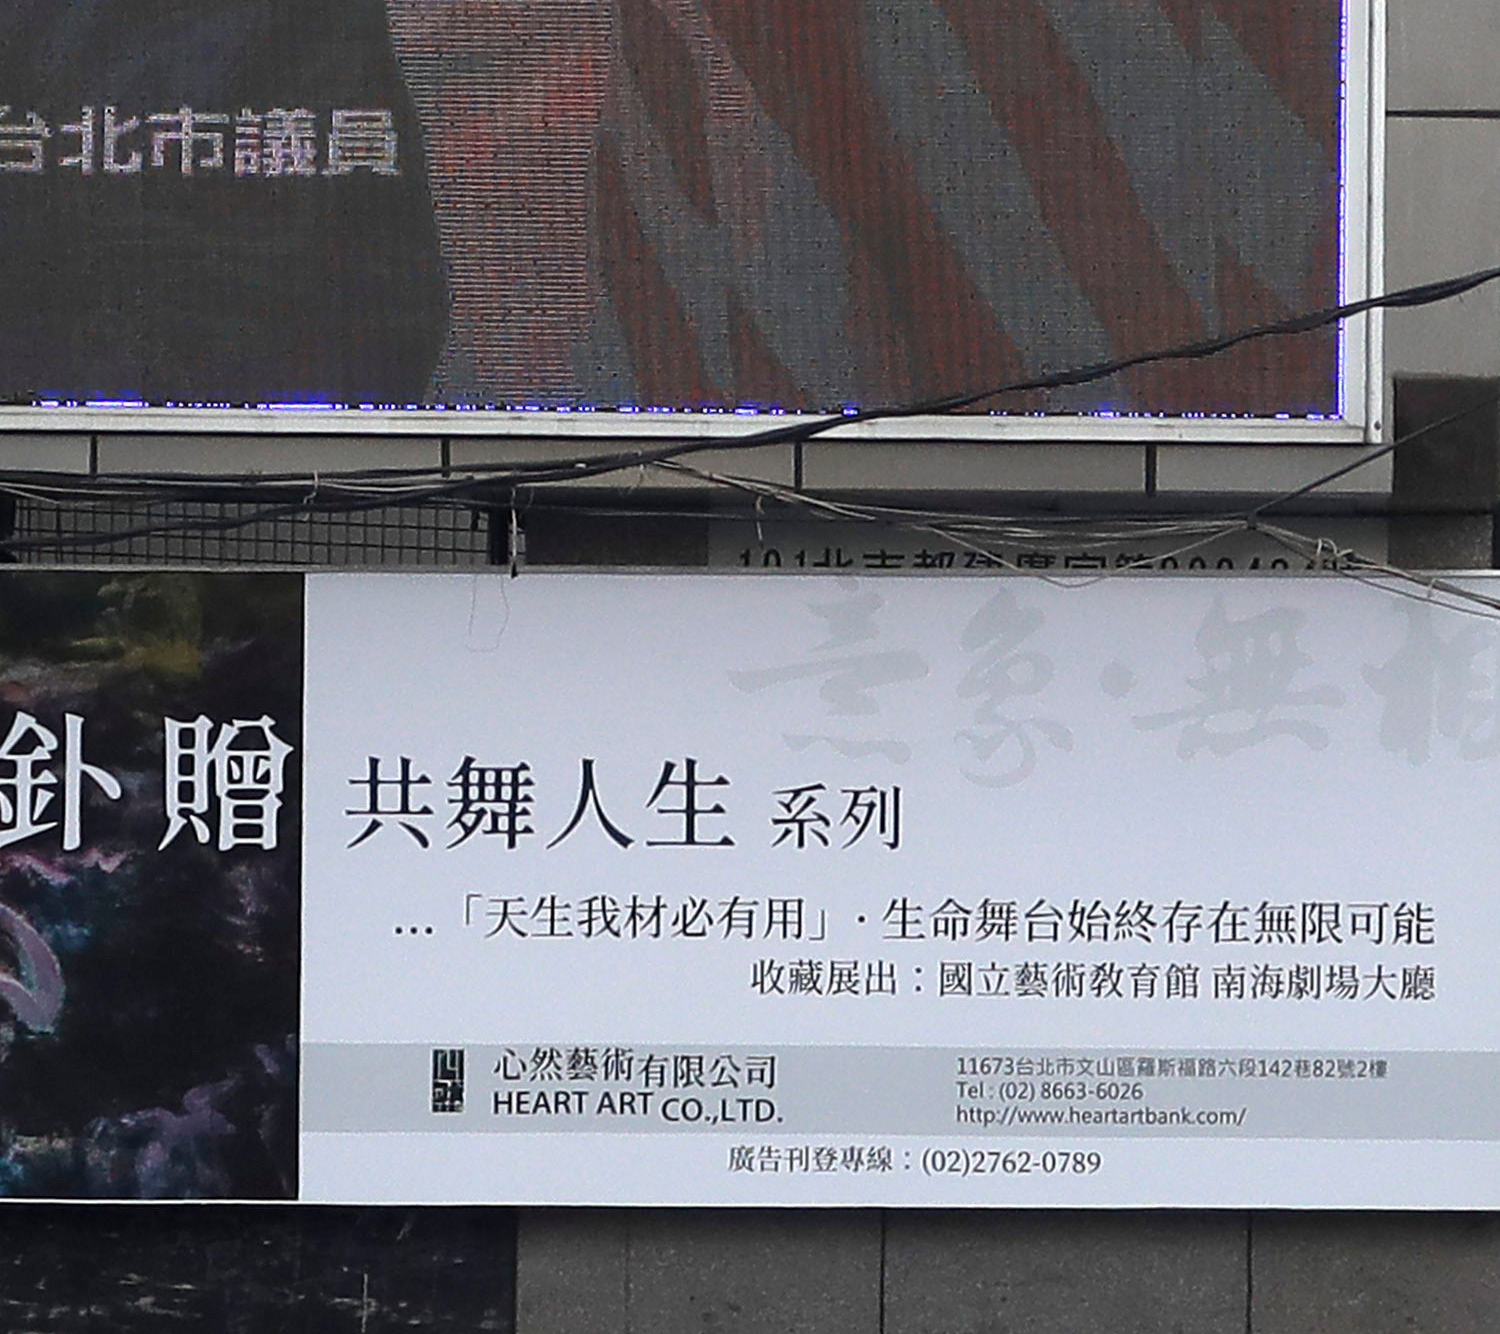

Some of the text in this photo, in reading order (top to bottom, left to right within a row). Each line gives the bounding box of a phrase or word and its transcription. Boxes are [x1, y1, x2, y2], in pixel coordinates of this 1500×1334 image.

[345, 755, 902, 851] 共舞人生 系列
[1212, 963, 1437, 1003] 南海劇場大廳
[493, 1091, 589, 1118] HEART
[596, 1091, 655, 1118] ART
[999, 1081, 1035, 1103] (02)
[1040, 1082, 1143, 1101] 8663-6026
[956, 1105, 1246, 1126] http://www.heartartbank.com/
